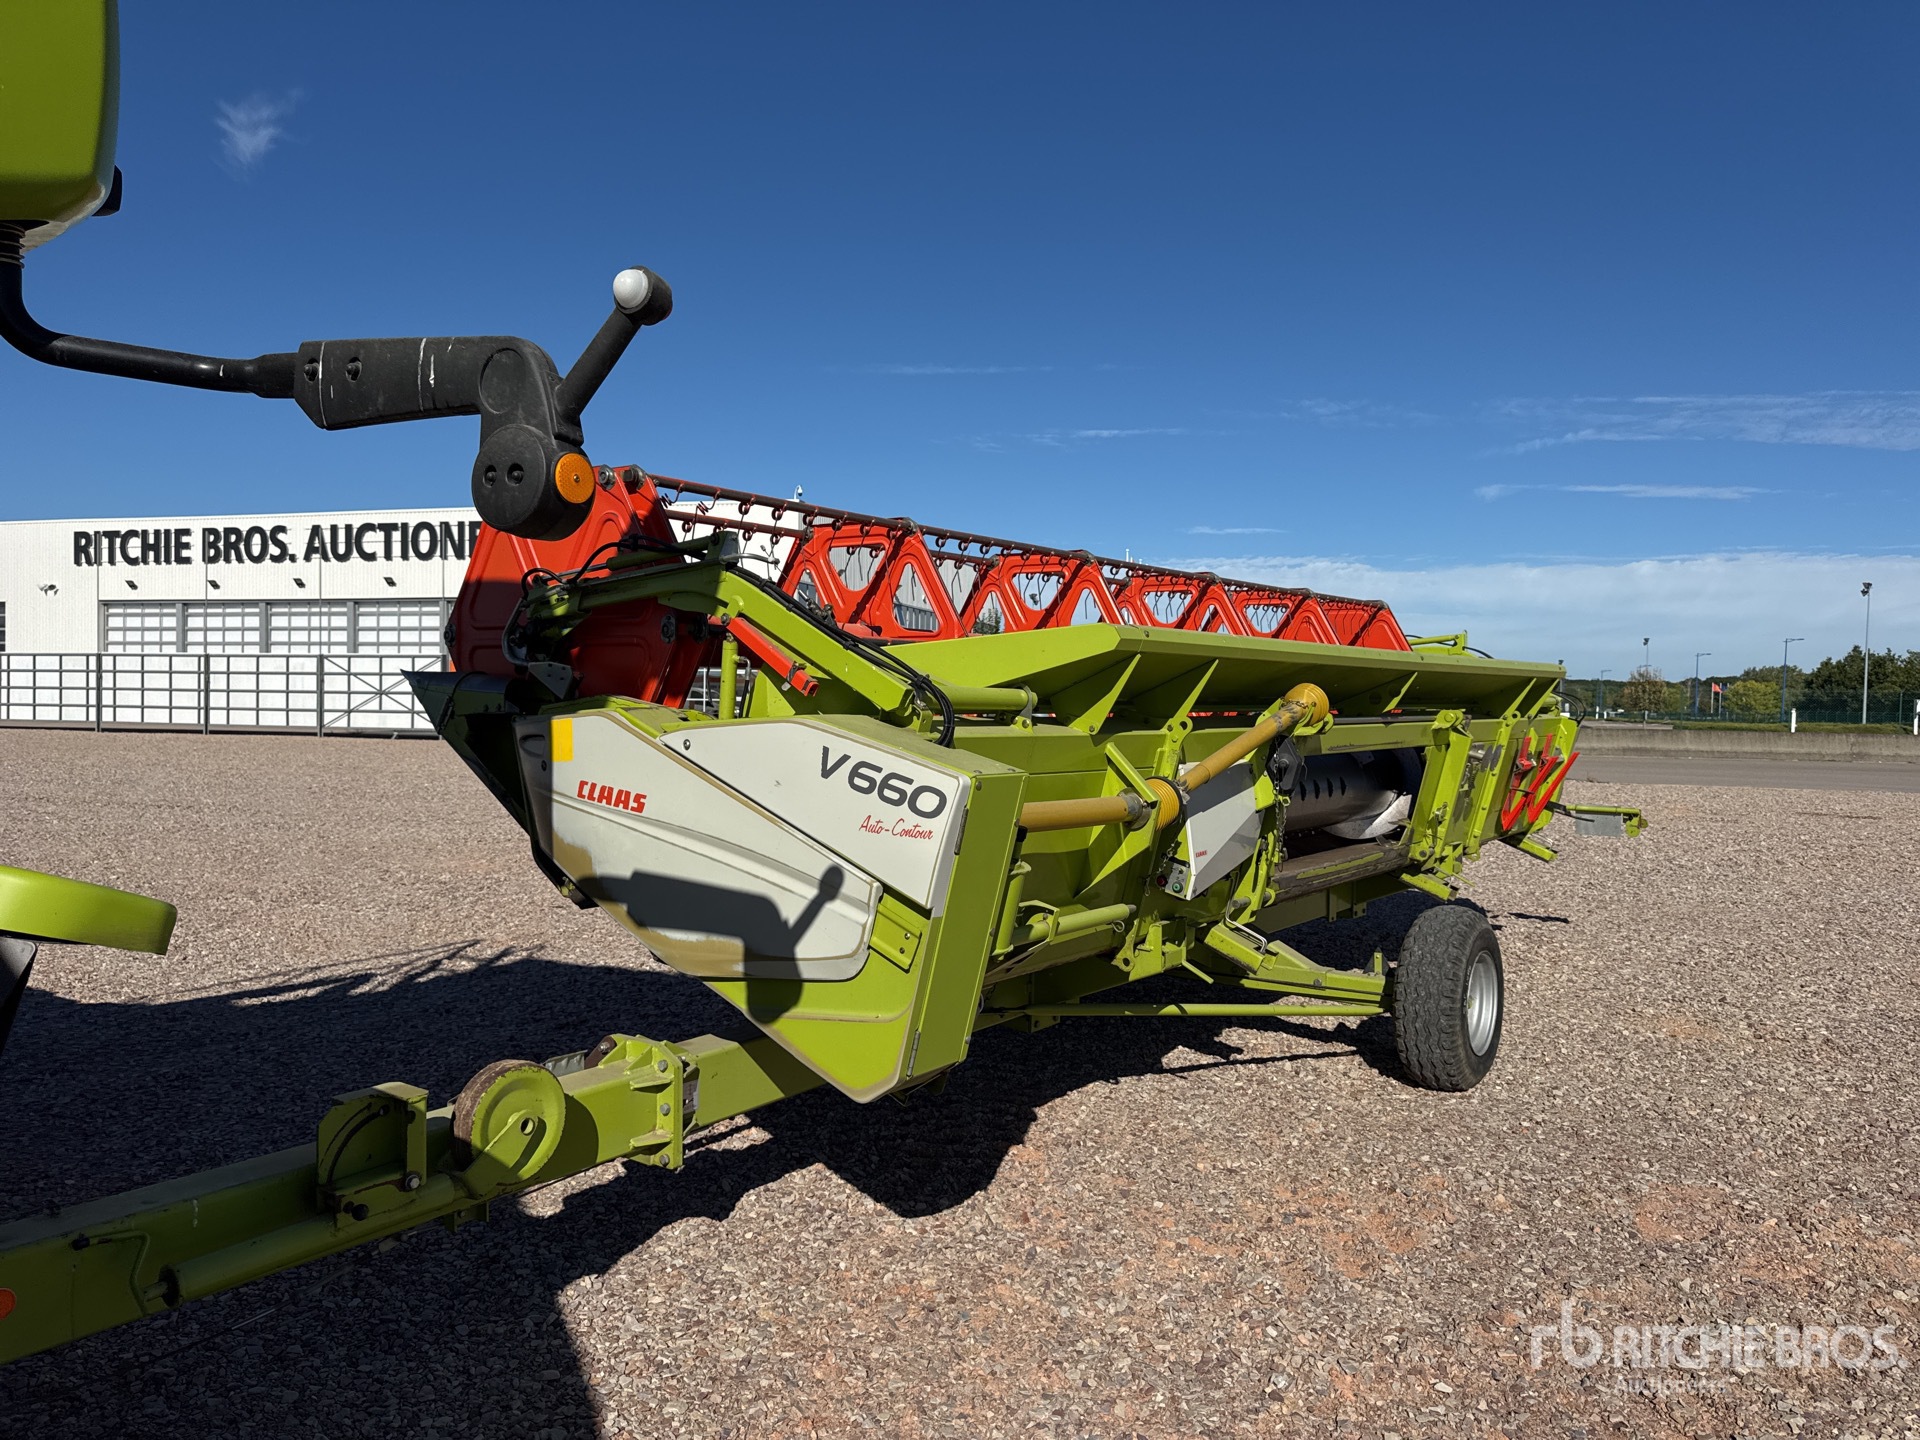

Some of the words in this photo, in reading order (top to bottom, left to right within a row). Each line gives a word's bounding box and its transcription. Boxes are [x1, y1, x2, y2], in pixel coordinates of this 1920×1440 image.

[73, 528, 193, 566] RITCHIE
[202, 525, 299, 564] BROS.
[577, 780, 647, 813] CLAAS
[859, 815, 934, 840] Auto-Contour
